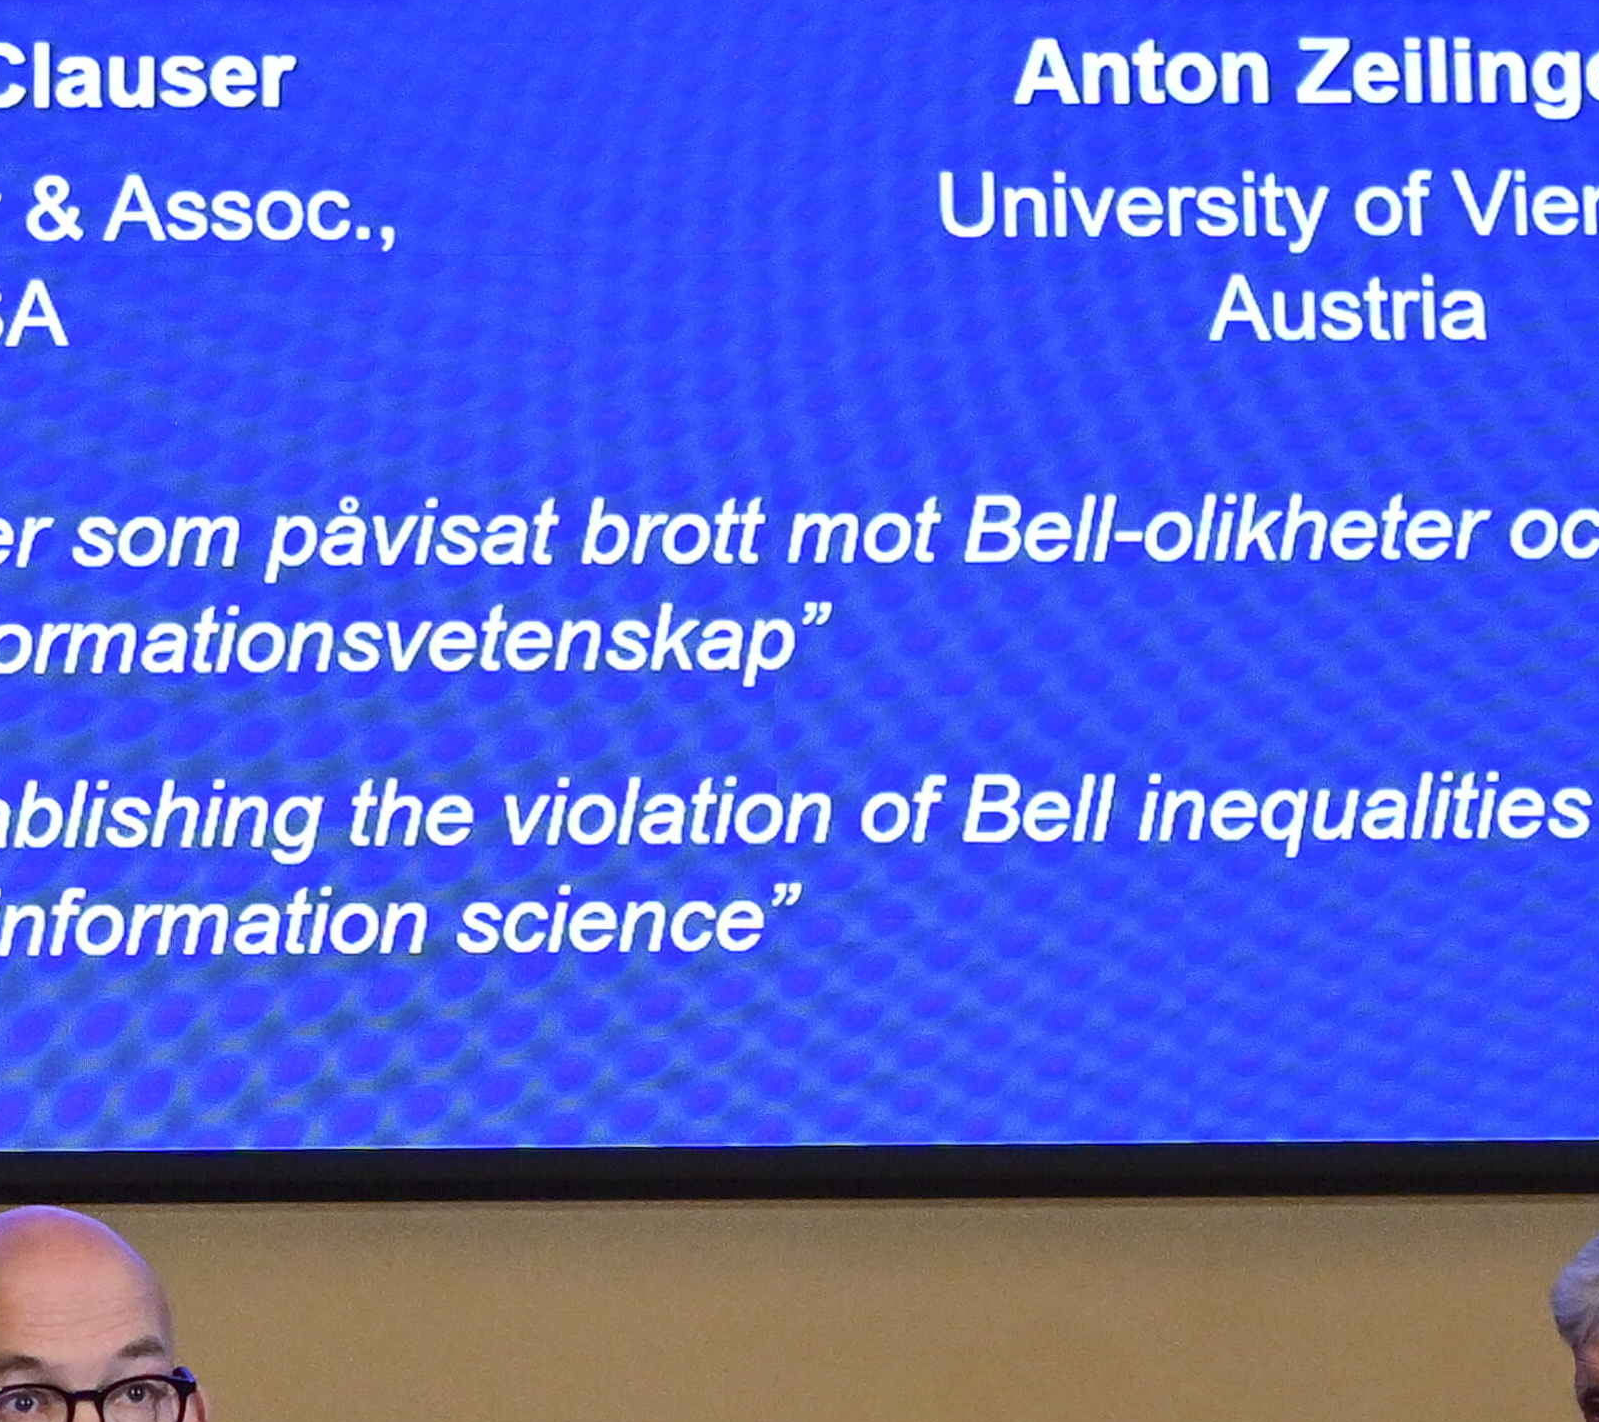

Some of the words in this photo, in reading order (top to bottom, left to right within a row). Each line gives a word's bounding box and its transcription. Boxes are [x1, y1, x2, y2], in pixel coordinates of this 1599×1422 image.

[1013, 36, 1270, 106] Anton
[24, 173, 85, 243] &
[102, 173, 396, 253] Assoc.,
[938, 169, 1331, 255] University
[1353, 168, 1434, 237] of
[1208, 272, 1488, 342] Austria
[71, 514, 241, 569] som
[263, 494, 561, 585] påvisat
[580, 495, 767, 566] brott
[786, 495, 943, 565] mot
[963, 491, 1493, 564] Bell-olikheter
[348, 776, 475, 848] the
[502, 774, 833, 847] violation
[859, 773, 948, 844] of
[961, 772, 1117, 844] Bell
[1137, 769, 1594, 859] inequalities
[455, 881, 803, 955] science”
